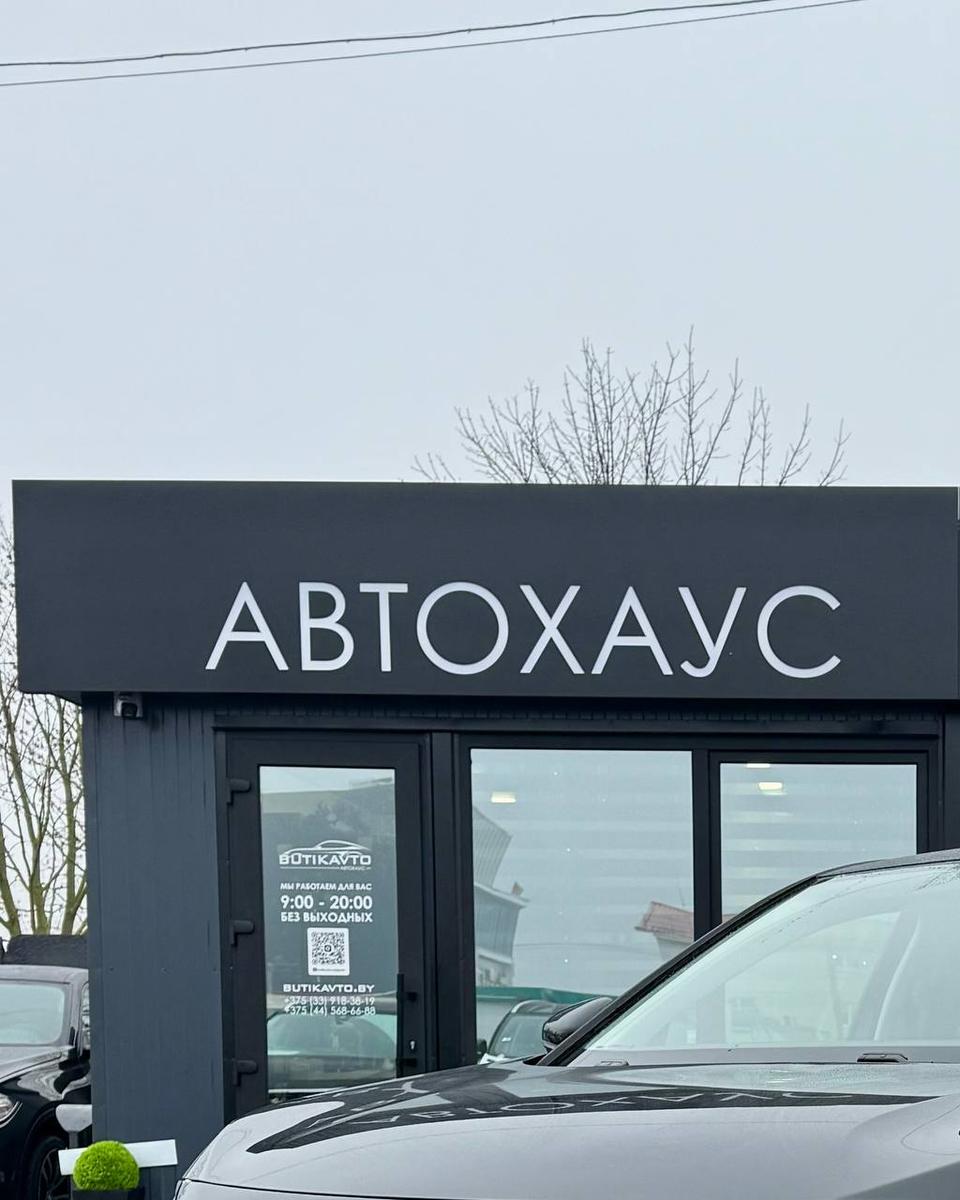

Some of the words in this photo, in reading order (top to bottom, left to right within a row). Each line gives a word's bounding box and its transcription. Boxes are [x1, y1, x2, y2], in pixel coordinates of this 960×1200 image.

[206, 581, 841, 679] АВТОХАУС
[279, 853, 372, 865] BUTIKAVTO
[280, 882, 294, 890] МЫ
[295, 882, 337, 890] РАБОТАЕМ
[337, 883, 354, 891] ДЛЯ
[355, 883, 373, 891] ВАС
[280, 895, 314, 909] 9:00
[330, 895, 373, 909] 20:00
[280, 911, 300, 922] БЕЗ
[303, 911, 373, 924] ВЫХОДНЫХ
[283, 984, 375, 993] BUTIKAVTO.BY
[309, 996, 328, 1006] (33)
[309, 1006, 328, 1016] (44)
